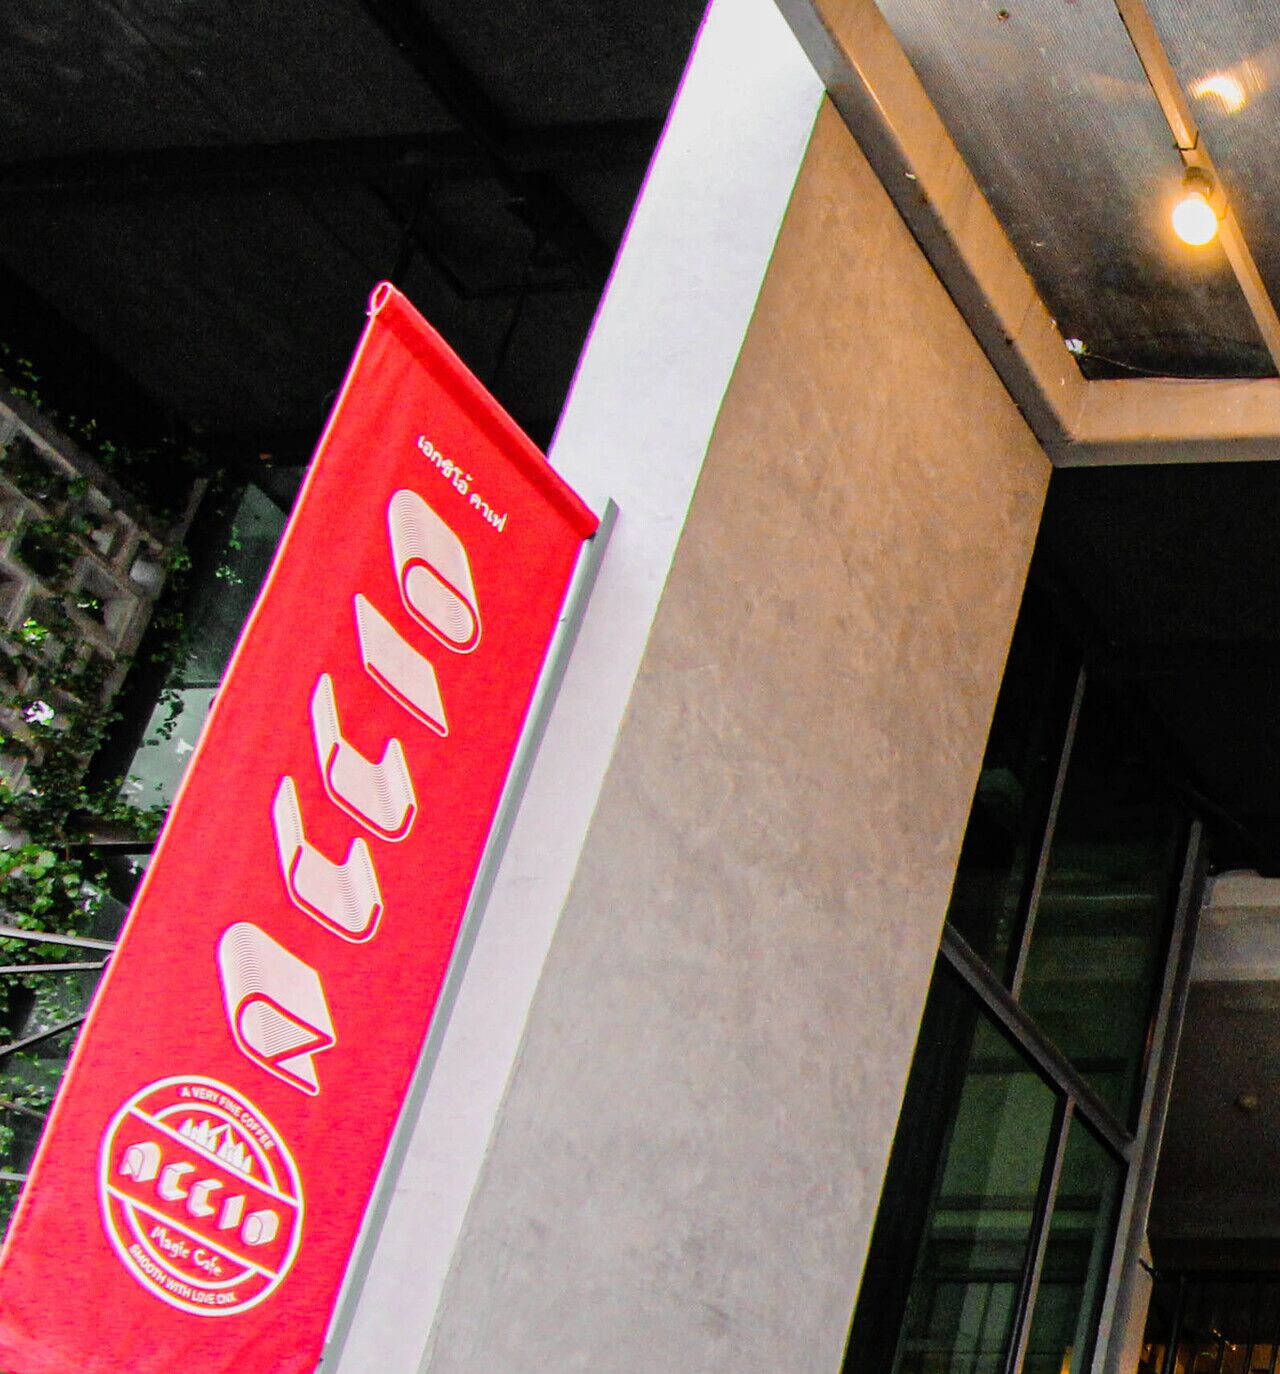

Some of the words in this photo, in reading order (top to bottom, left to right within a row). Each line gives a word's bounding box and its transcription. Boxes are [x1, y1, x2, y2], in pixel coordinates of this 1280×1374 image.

[191, 1086, 220, 1103] VERY
[218, 1096, 243, 1118] FINE
[240, 1112, 276, 1150] COFFEE
[151, 1226, 191, 1258] Magic
[128, 1243, 167, 1284] SMOOTH
[165, 1278, 193, 1298] WITH
[191, 1289, 217, 1304] LOVE
